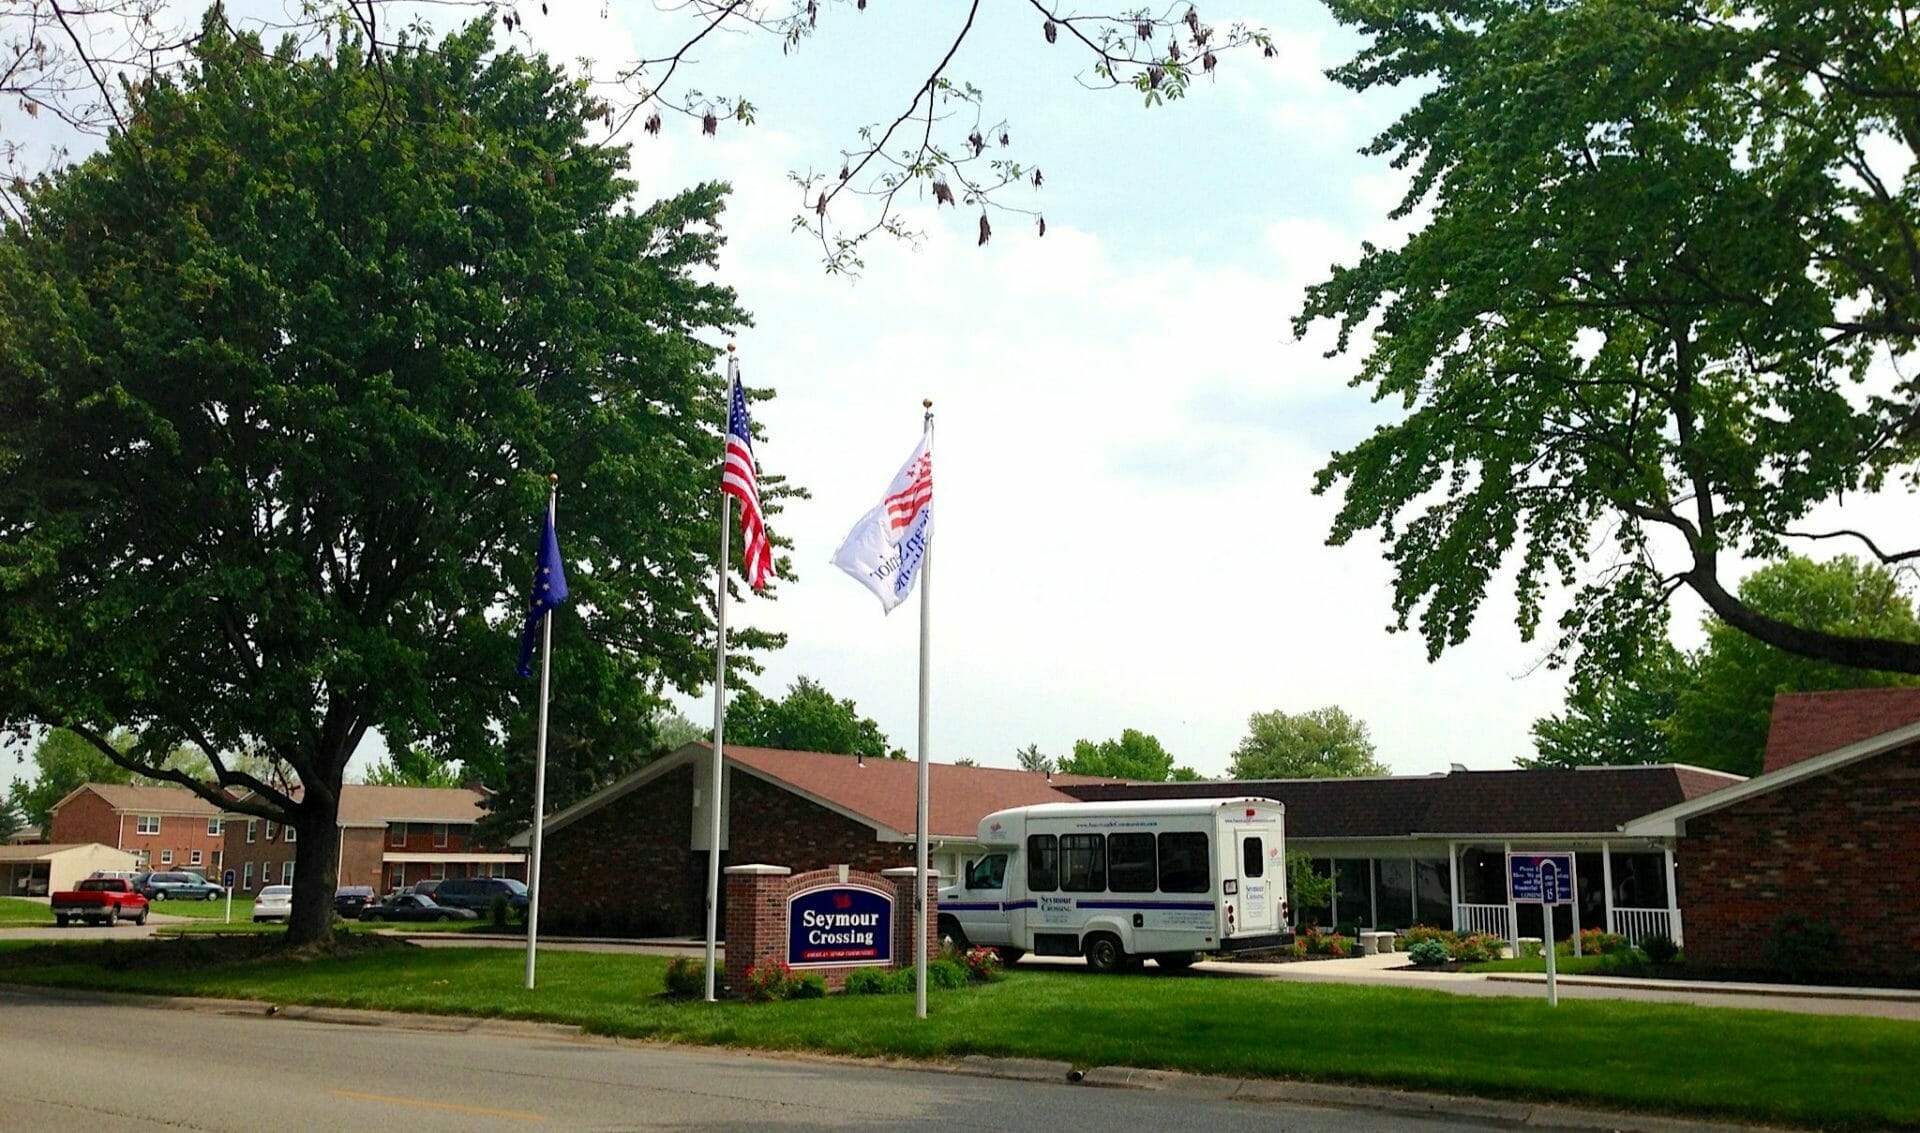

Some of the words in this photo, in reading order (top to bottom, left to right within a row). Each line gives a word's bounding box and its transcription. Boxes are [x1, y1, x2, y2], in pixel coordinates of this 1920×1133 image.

[1546, 888, 1554, 900] 15
[803, 910, 879, 930] Seymour
[808, 929, 873, 945] Crossing
